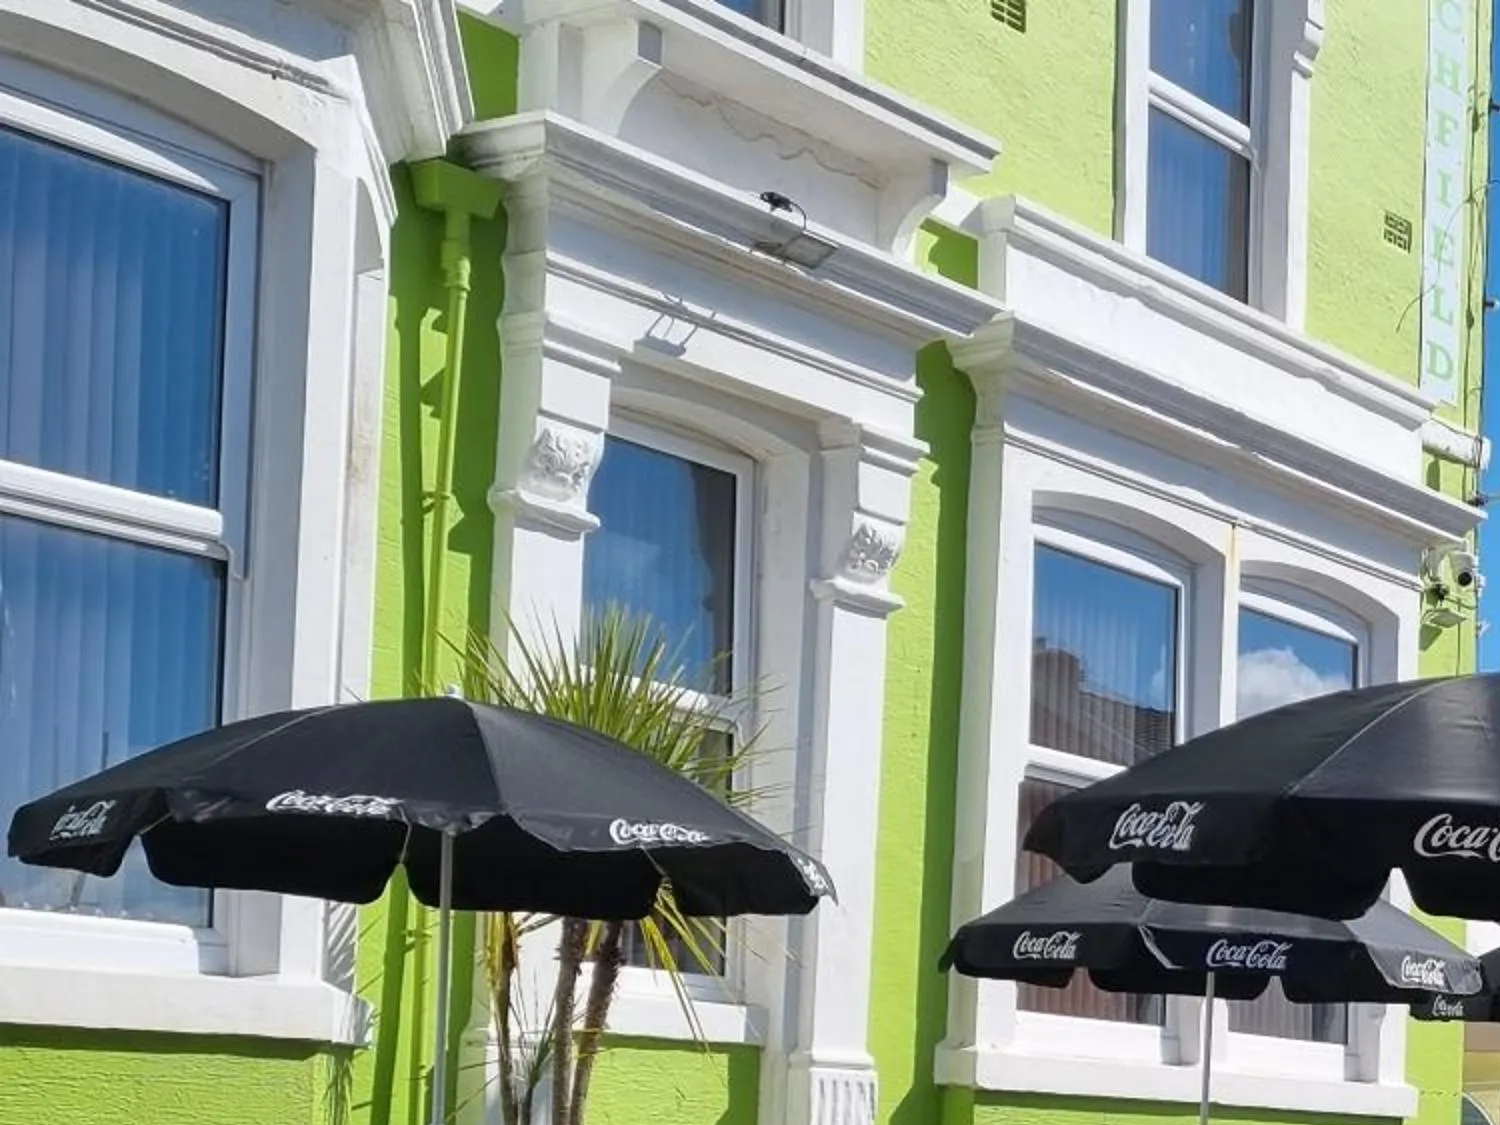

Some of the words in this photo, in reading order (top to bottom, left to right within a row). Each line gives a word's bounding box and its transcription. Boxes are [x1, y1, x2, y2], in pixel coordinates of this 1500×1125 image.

[1108, 801, 1205, 852] Coca-Cola
[1013, 931, 1081, 961] Coca-Cola
[1205, 938, 1292, 970] Coca-Cola
